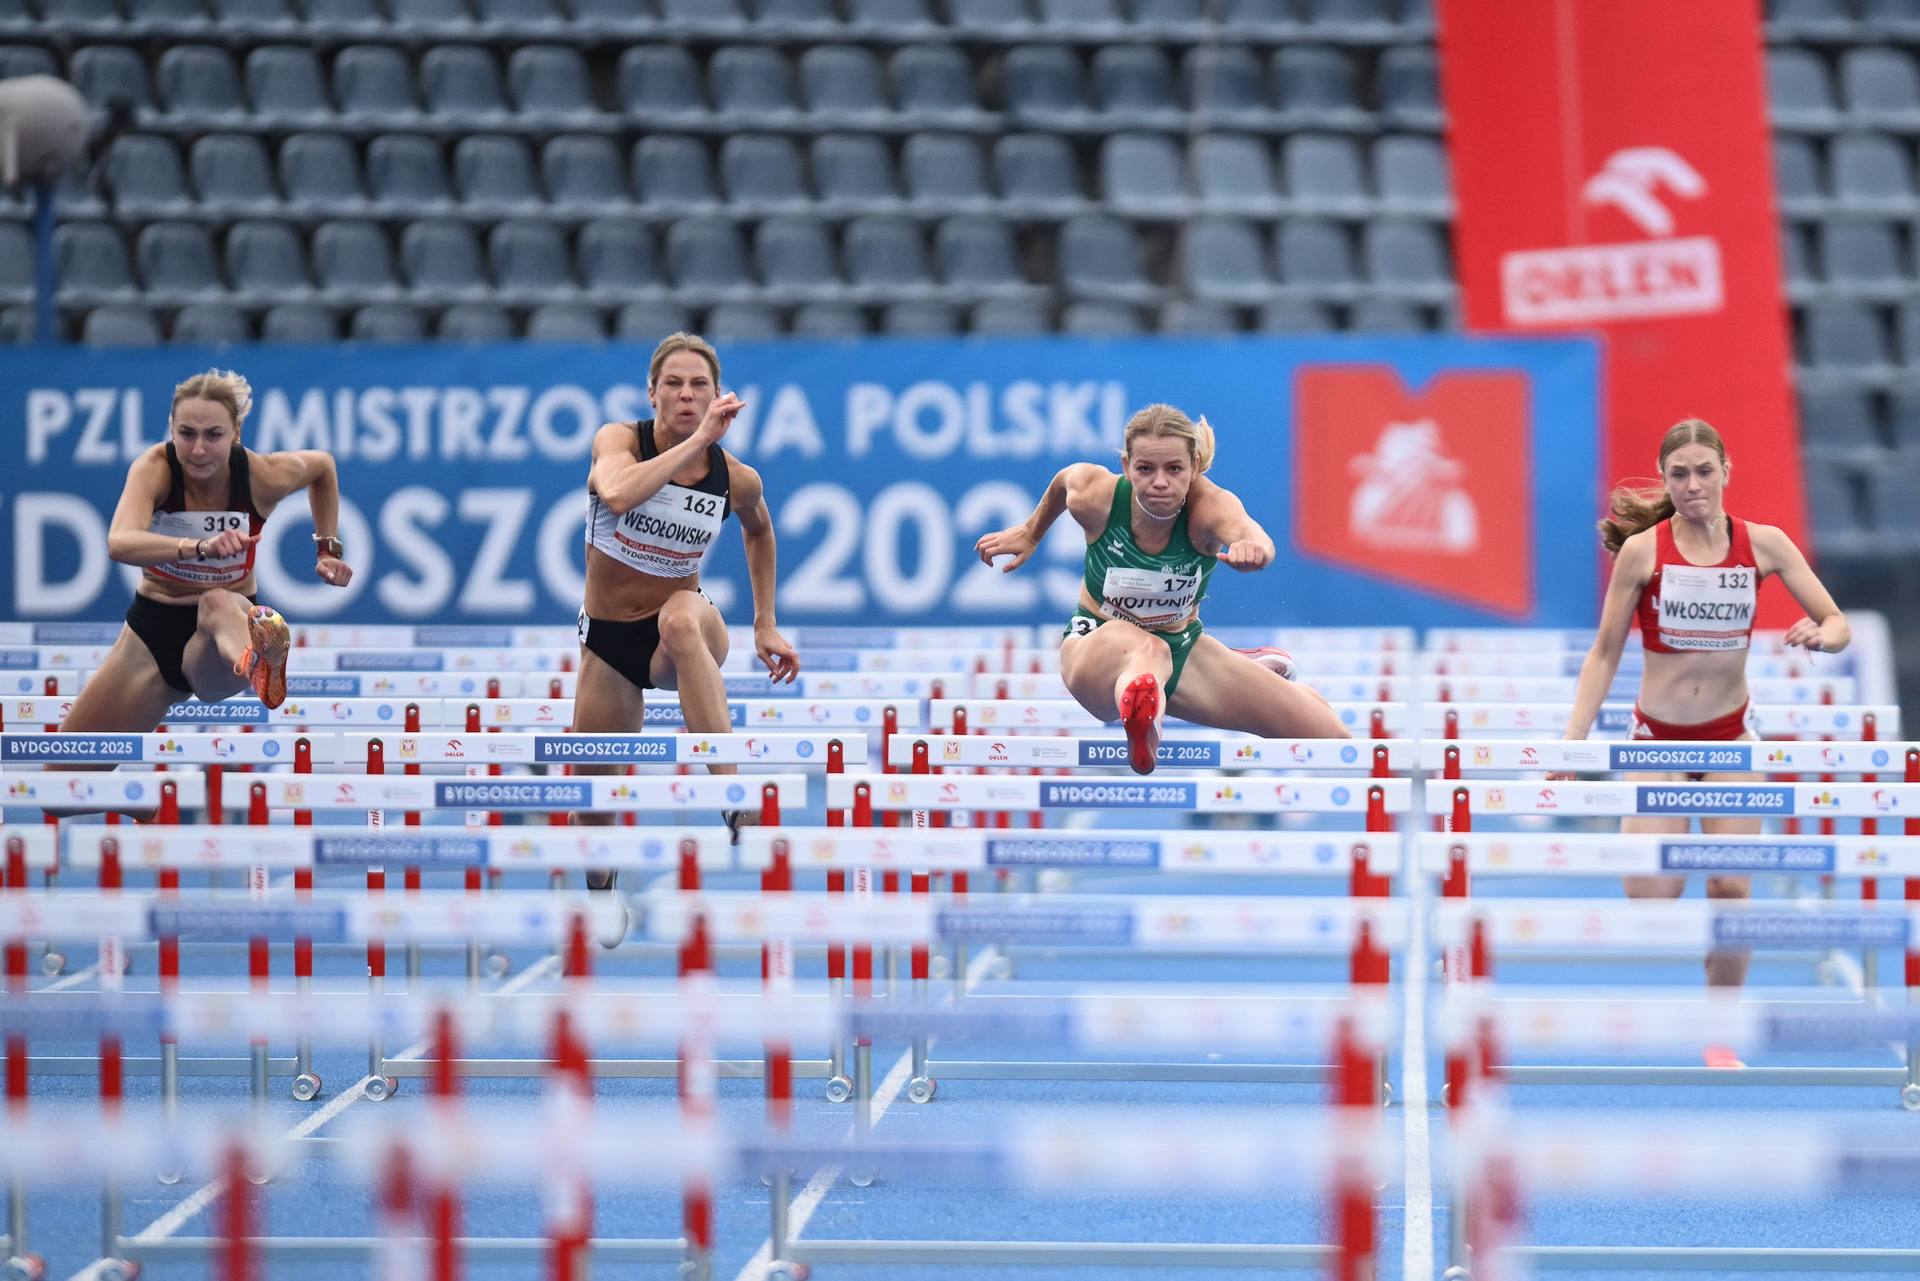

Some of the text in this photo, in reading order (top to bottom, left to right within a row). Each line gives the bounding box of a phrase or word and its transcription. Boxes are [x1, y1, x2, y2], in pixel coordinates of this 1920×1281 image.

[1520, 254, 1702, 306] ORLEN
[27, 382, 1127, 463] PZL MISTRZOSA POLSKI
[683, 495, 716, 516] 162
[203, 516, 240, 532] 319
[623, 511, 711, 545] WESOŁOWSKA
[621, 546, 690, 567] BYDGOSZCZ 2025
[211, 573, 233, 582] 2025
[1164, 577, 1197, 592] 178
[1718, 573, 1748, 588] 132
[1664, 599, 1751, 621] WŁOSZCZYK
[1077, 619, 1091, 636] 3
[1669, 638, 1739, 648] BYDGOSZCZ 2025
[166, 705, 261, 718] DGOSZCZ 2025
[11, 741, 133, 754] BYDGOSZCZ 2025
[545, 743, 667, 756] BYDGOSZCZ 2025
[1089, 746, 1211, 760] BYDGCZ 2025
[1620, 751, 1742, 764] BYDGOSZCZ 2025
[445, 786, 583, 801] BYDGOSZCZ 2025
[1050, 787, 1188, 802] BYDGOSZCZ 2025
[1647, 792, 1785, 807] BYDGOSZCZ 2025
